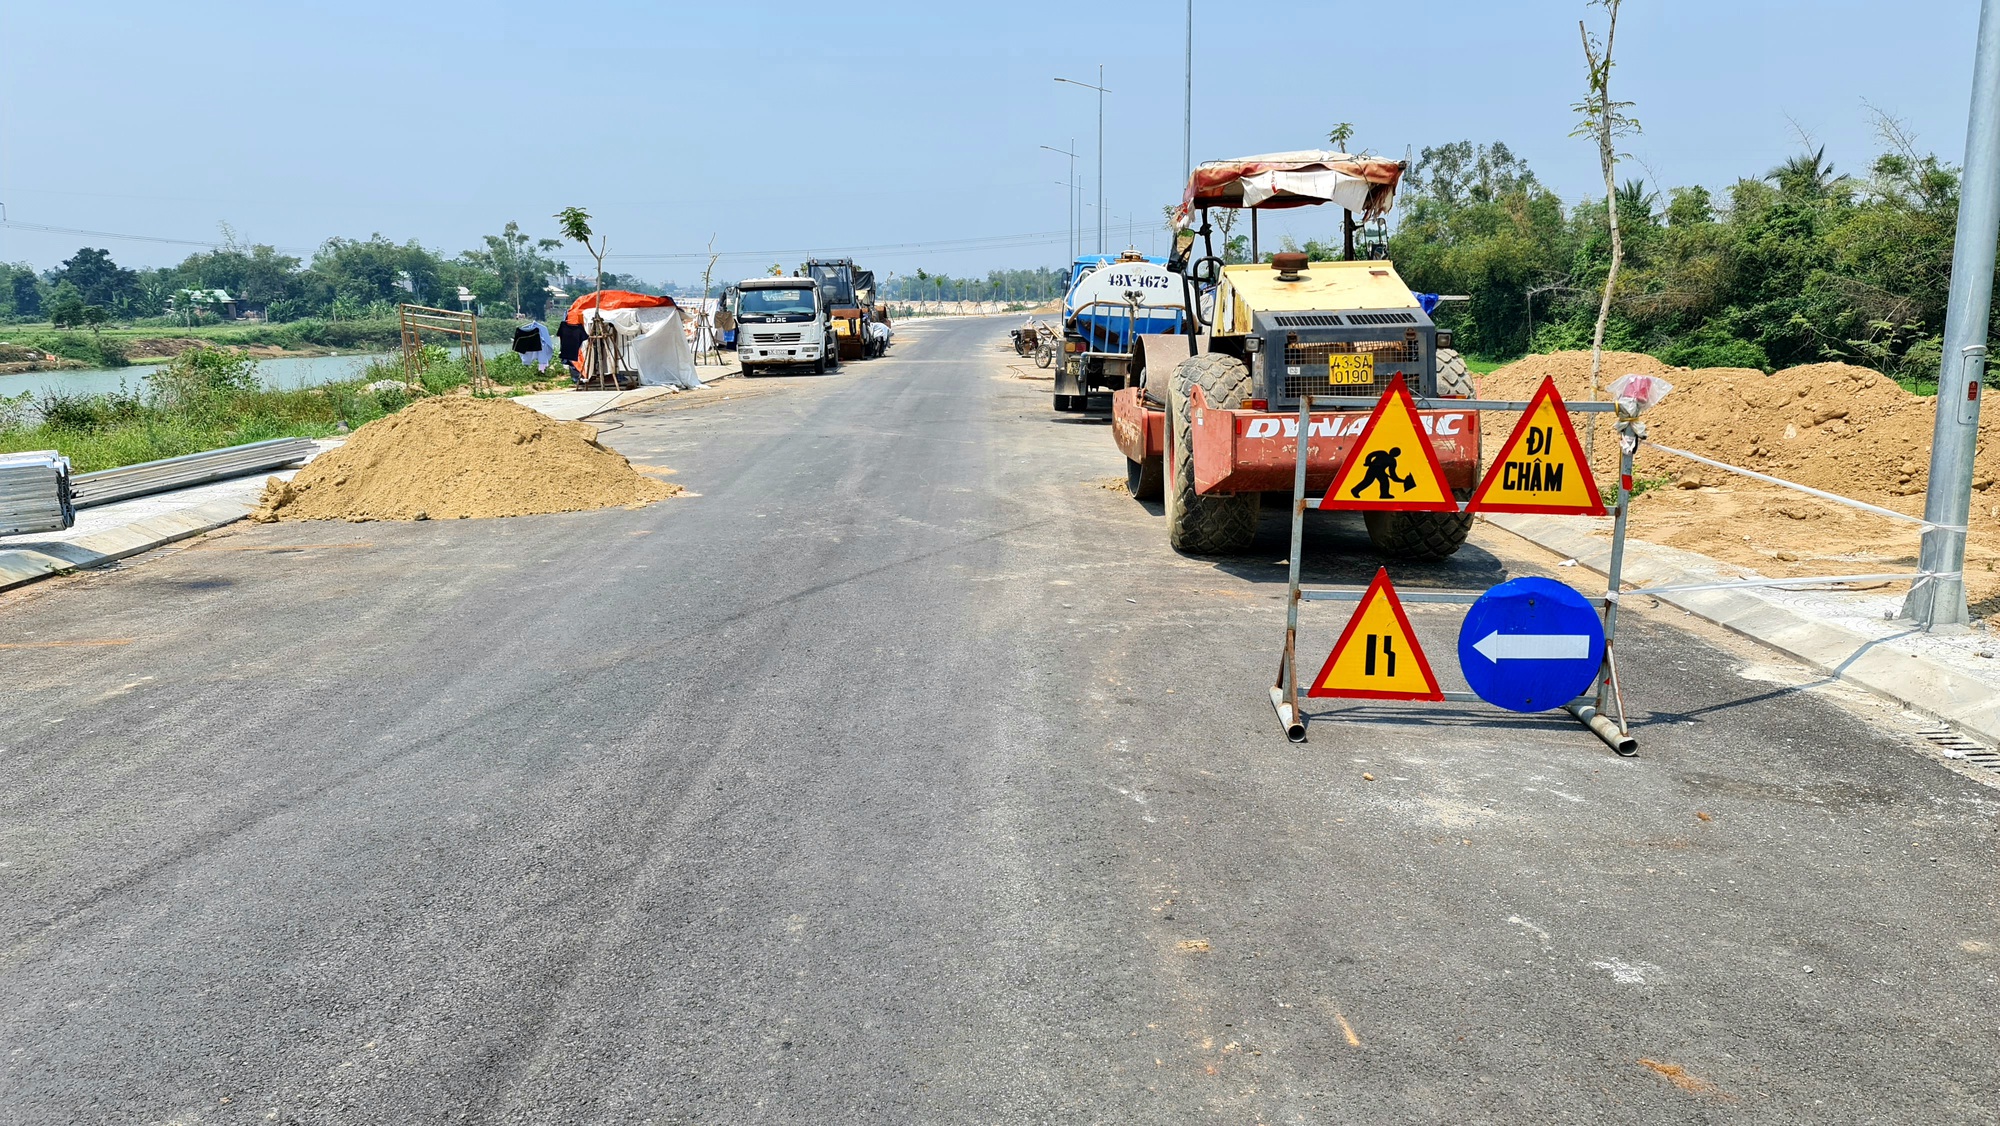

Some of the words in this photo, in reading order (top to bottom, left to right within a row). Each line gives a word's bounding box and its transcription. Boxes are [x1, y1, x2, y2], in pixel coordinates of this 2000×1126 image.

[1107, 273, 1169, 289] 43X-4672
[1333, 355, 1369, 369] 43-SA
[1245, 414, 1464, 438] DYNAC
[1526, 426, 1553, 455] ĐI
[1503, 457, 1564, 496] CHẬM
